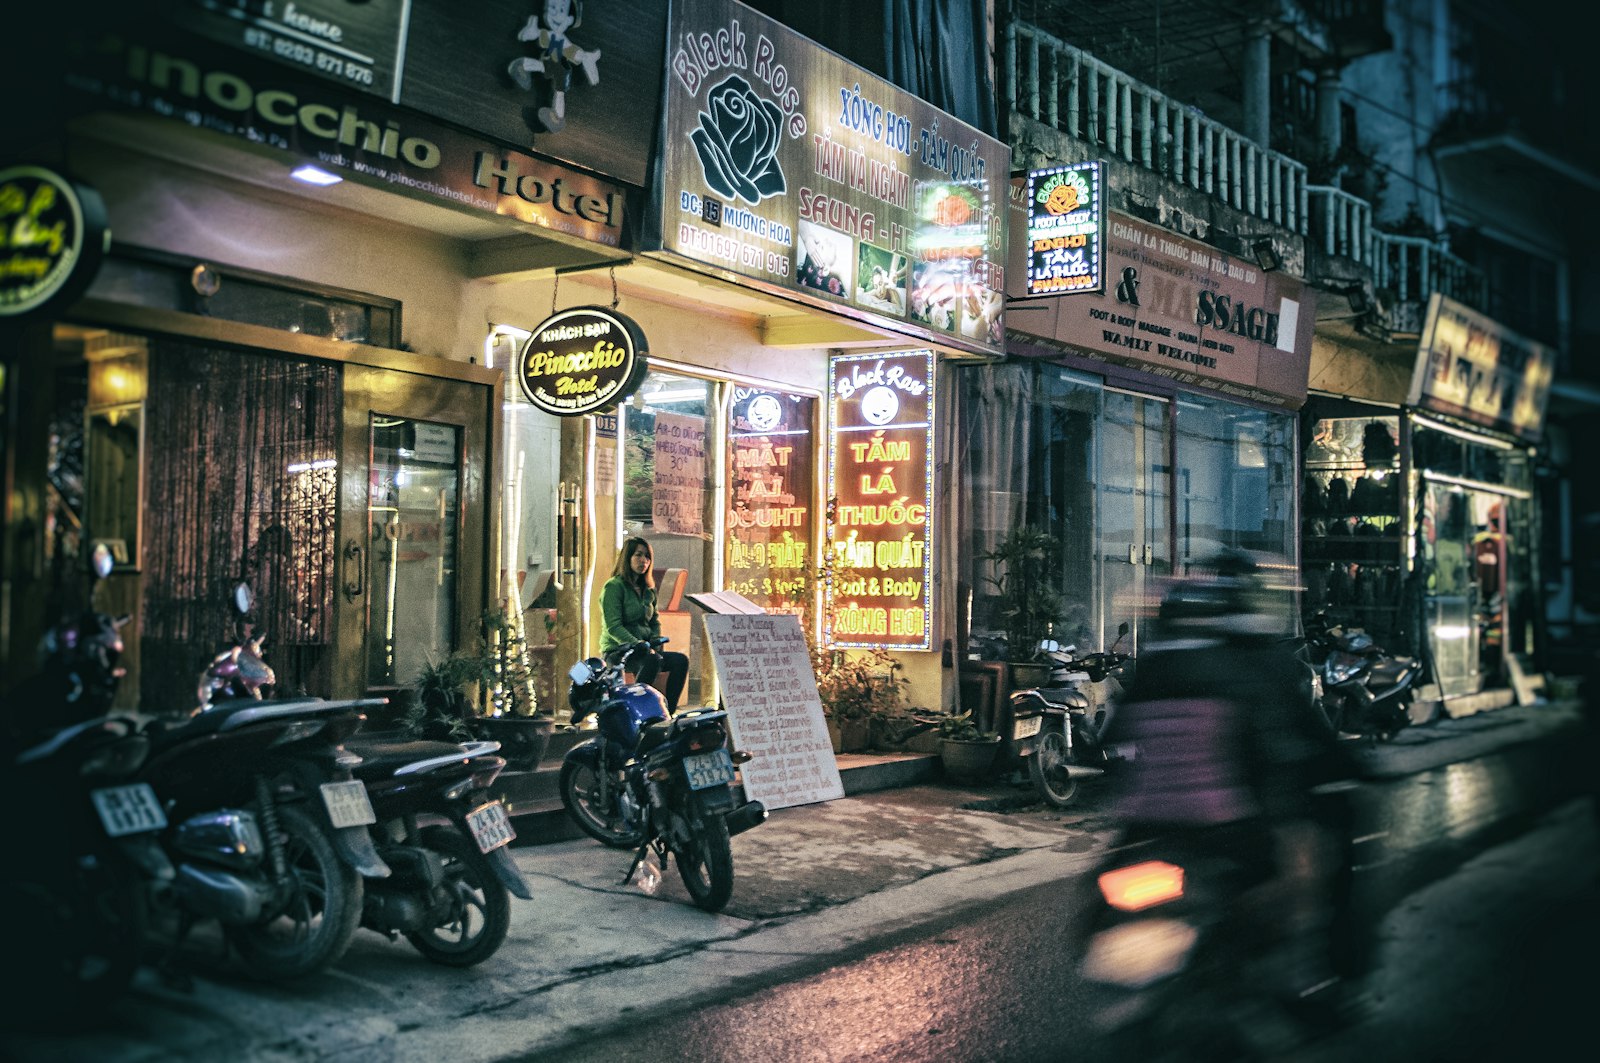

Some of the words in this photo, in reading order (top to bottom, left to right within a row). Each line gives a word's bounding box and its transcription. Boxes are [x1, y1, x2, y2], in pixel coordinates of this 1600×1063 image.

[673, 19, 747, 97] Black
[754, 34, 807, 139] Rose
[839, 82, 883, 142] XÔNG
[885, 110, 911, 156] HƠI
[950, 139, 986, 191] QUẤT
[354, 160, 498, 211] www.pinocchiohotel.com
[474, 151, 623, 226] Hotel
[848, 146, 867, 194] VÀ
[870, 160, 910, 211] NGÂM
[1036, 173, 1064, 203] Black
[1065, 171, 1089, 204] Rose
[680, 190, 703, 216] ĐC:
[705, 200, 718, 222] 15
[723, 206, 767, 239] MƯỜNG
[768, 220, 792, 247] HOA
[798, 187, 875, 242] SAUNA
[742, 245, 765, 271] 671
[767, 252, 789, 277] 915
[1115, 266, 1140, 306] &
[541, 325, 583, 343] KHÁCH
[583, 321, 611, 338] SẠN
[1089, 307, 1109, 321] FOOT
[1118, 315, 1136, 328] BODY
[1138, 321, 1172, 337] MASSAGE
[527, 340, 626, 378] Pinocchio
[1102, 329, 1152, 353] WAMLY
[1157, 343, 1217, 369] WELCOME
[555, 375, 599, 396] Hotel
[837, 360, 885, 400] Black
[886, 365, 926, 395] Rose
[597, 416, 616, 430] 015
[850, 430, 910, 463] TẮM
[861, 466, 897, 494] LÁ
[838, 496, 926, 525] THUỐC
[875, 532, 924, 571] QUẤT
[868, 577, 881, 596] &
[882, 577, 921, 601] Body
[833, 602, 887, 635] XÔNG
